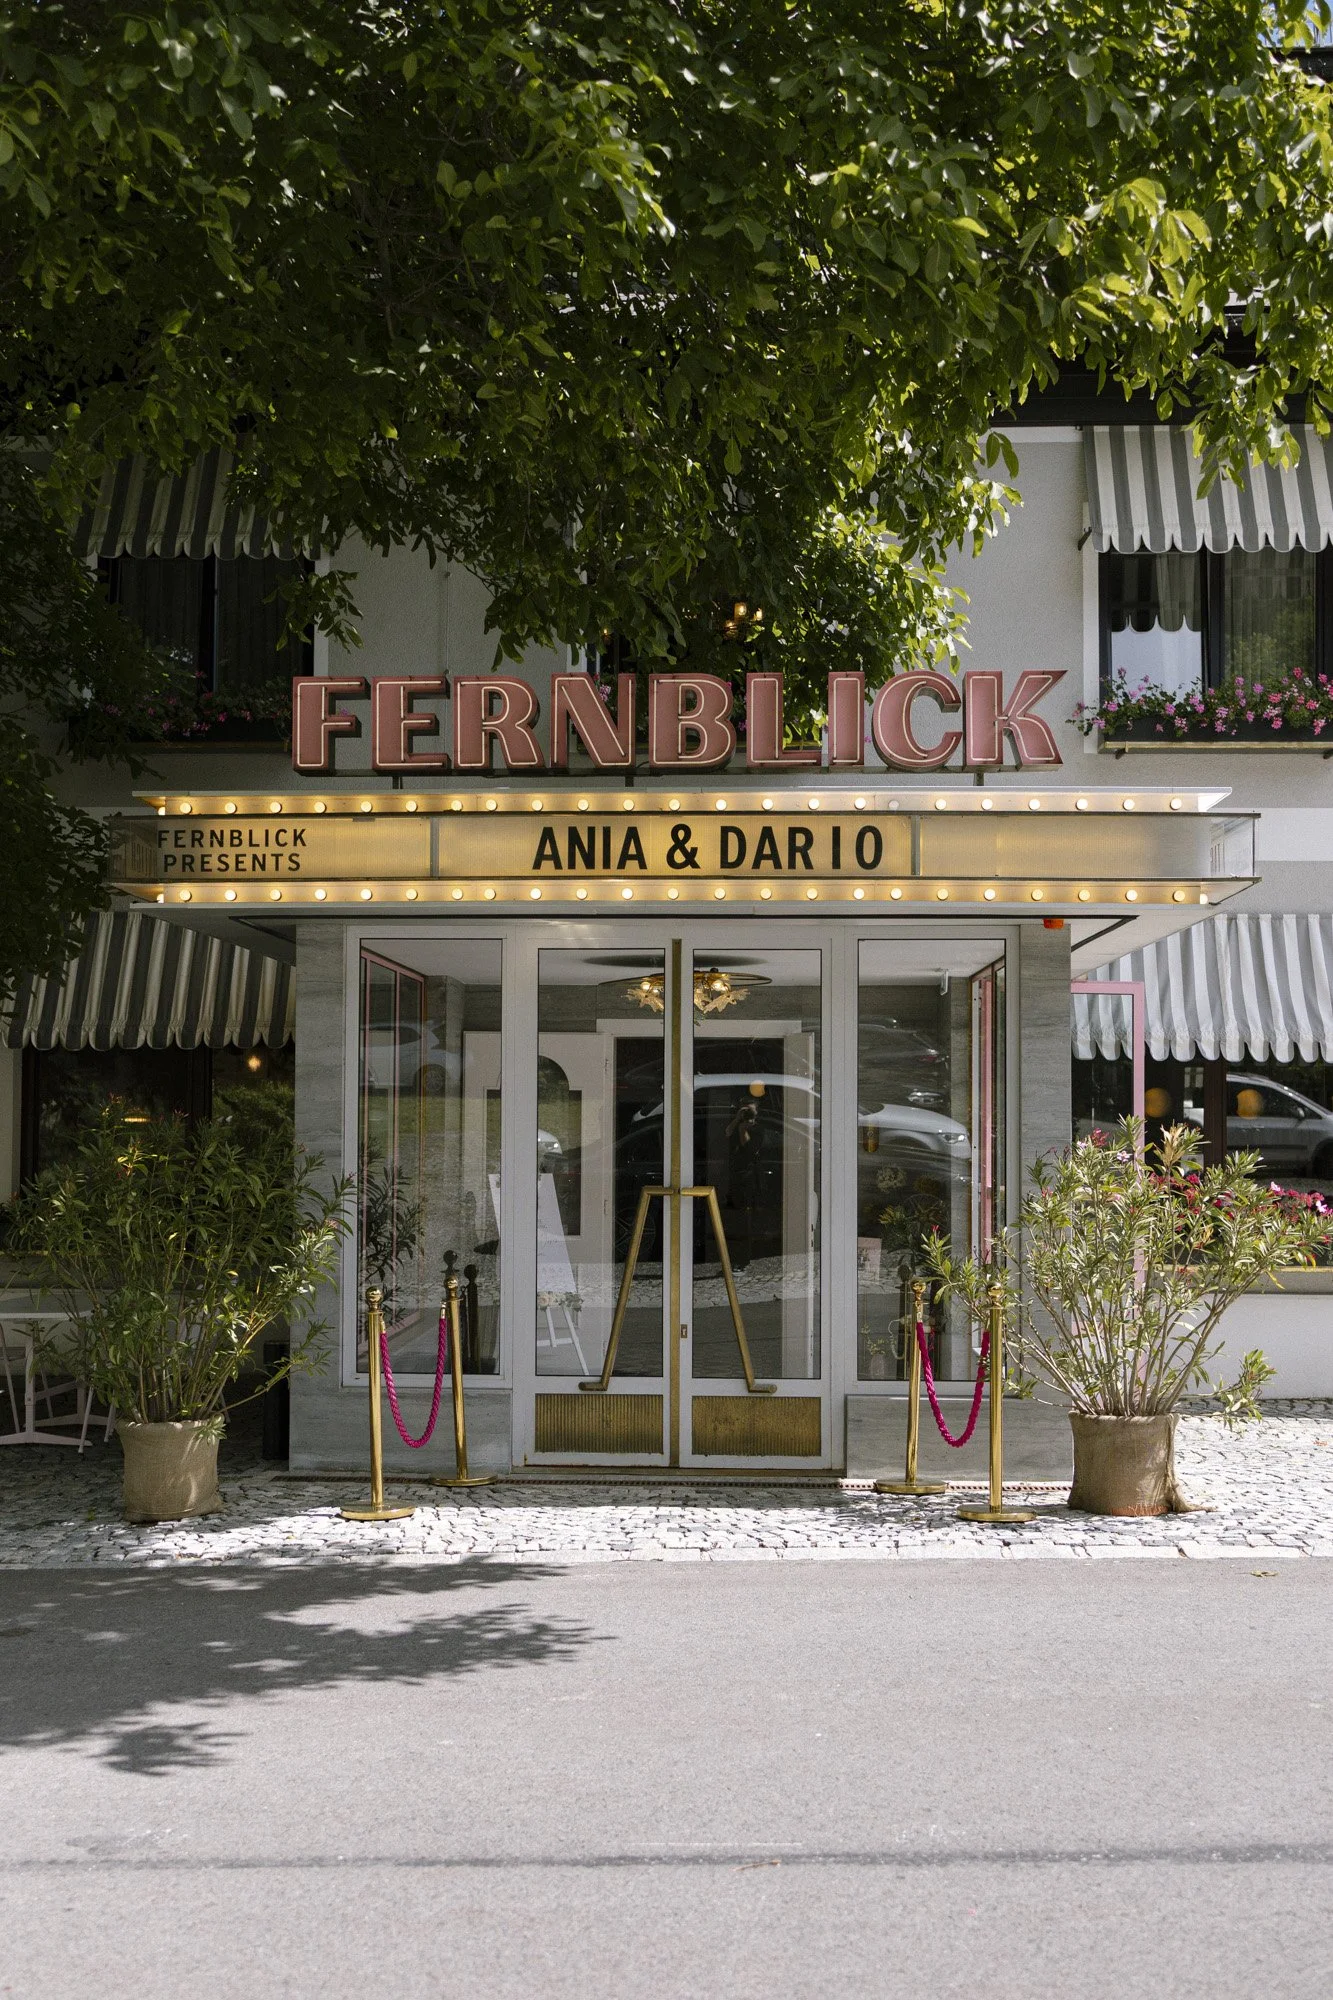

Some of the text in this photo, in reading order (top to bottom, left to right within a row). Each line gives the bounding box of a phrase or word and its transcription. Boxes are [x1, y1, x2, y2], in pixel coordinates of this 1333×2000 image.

[292, 669, 1068, 771] FERNBLICK
[158, 828, 307, 849] FERNBLICK
[532, 823, 883, 871] ANIA & DARIO
[163, 852, 301, 873] PRESENTS
